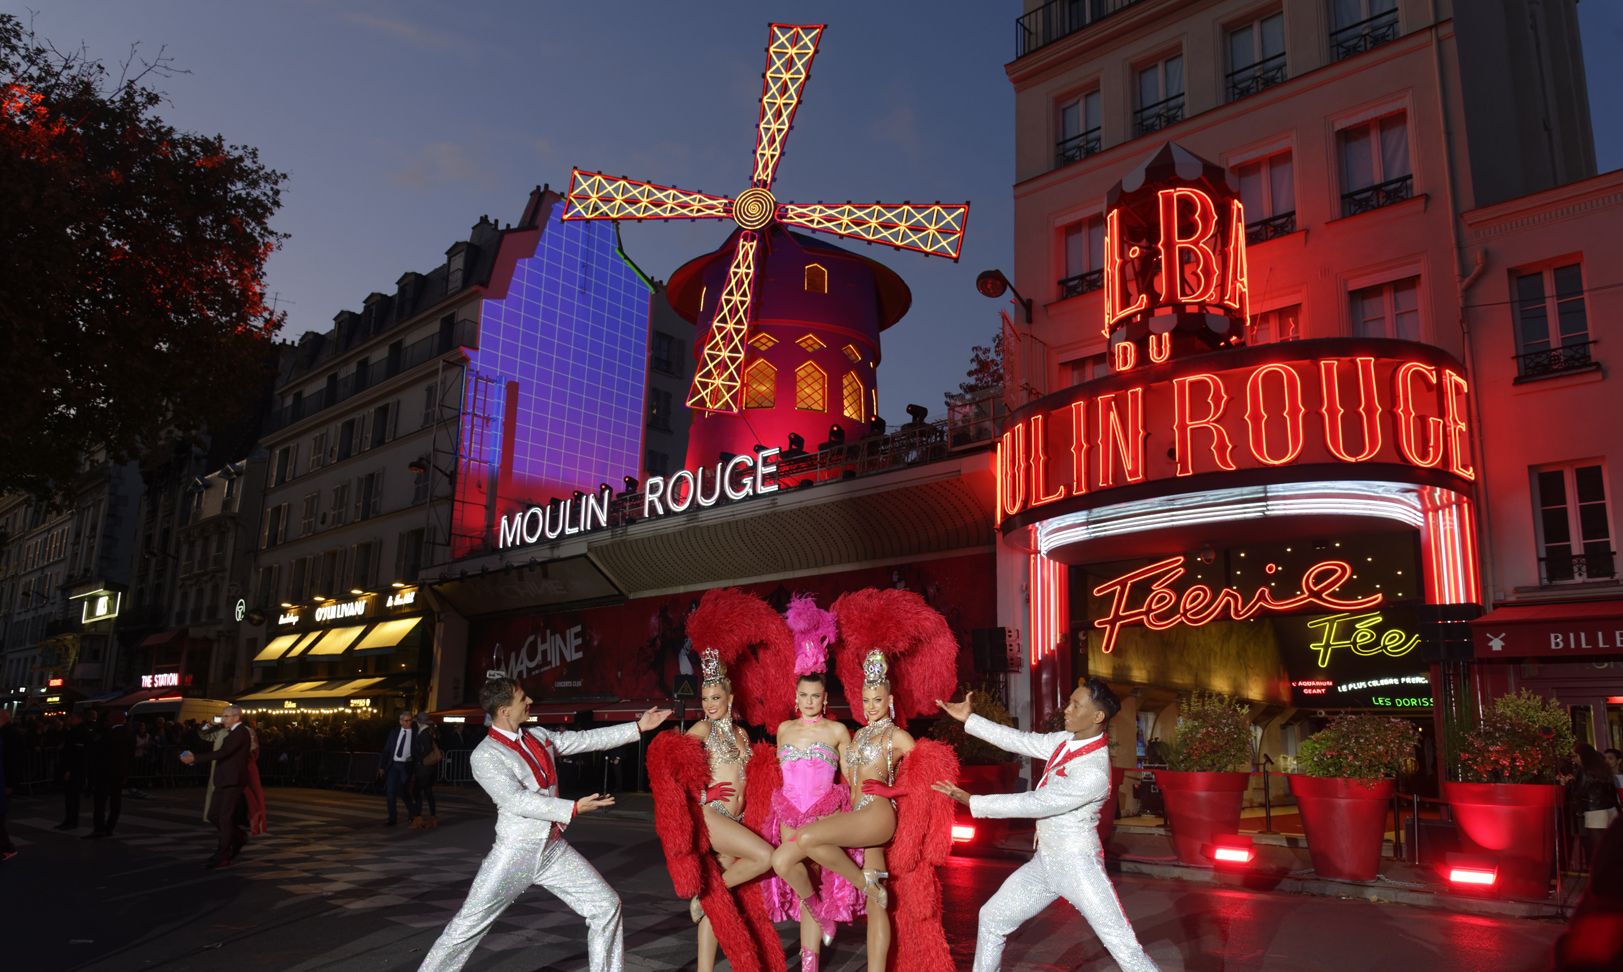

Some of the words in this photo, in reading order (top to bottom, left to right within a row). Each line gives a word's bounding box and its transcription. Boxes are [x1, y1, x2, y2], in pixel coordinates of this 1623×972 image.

[1115, 331, 1171, 372] DU
[1172, 356, 1476, 481] ROUGE
[498, 489, 611, 549] MOULIN
[643, 447, 780, 518] ROUGE
[1093, 555, 1384, 655] Féerie
[1307, 611, 1422, 668] Fée
[141, 675, 153, 688] THE
[154, 672, 179, 687] STATION
[1337, 685, 1348, 693] LE
[1348, 681, 1367, 691] PLUS
[1372, 696, 1392, 706] LES
